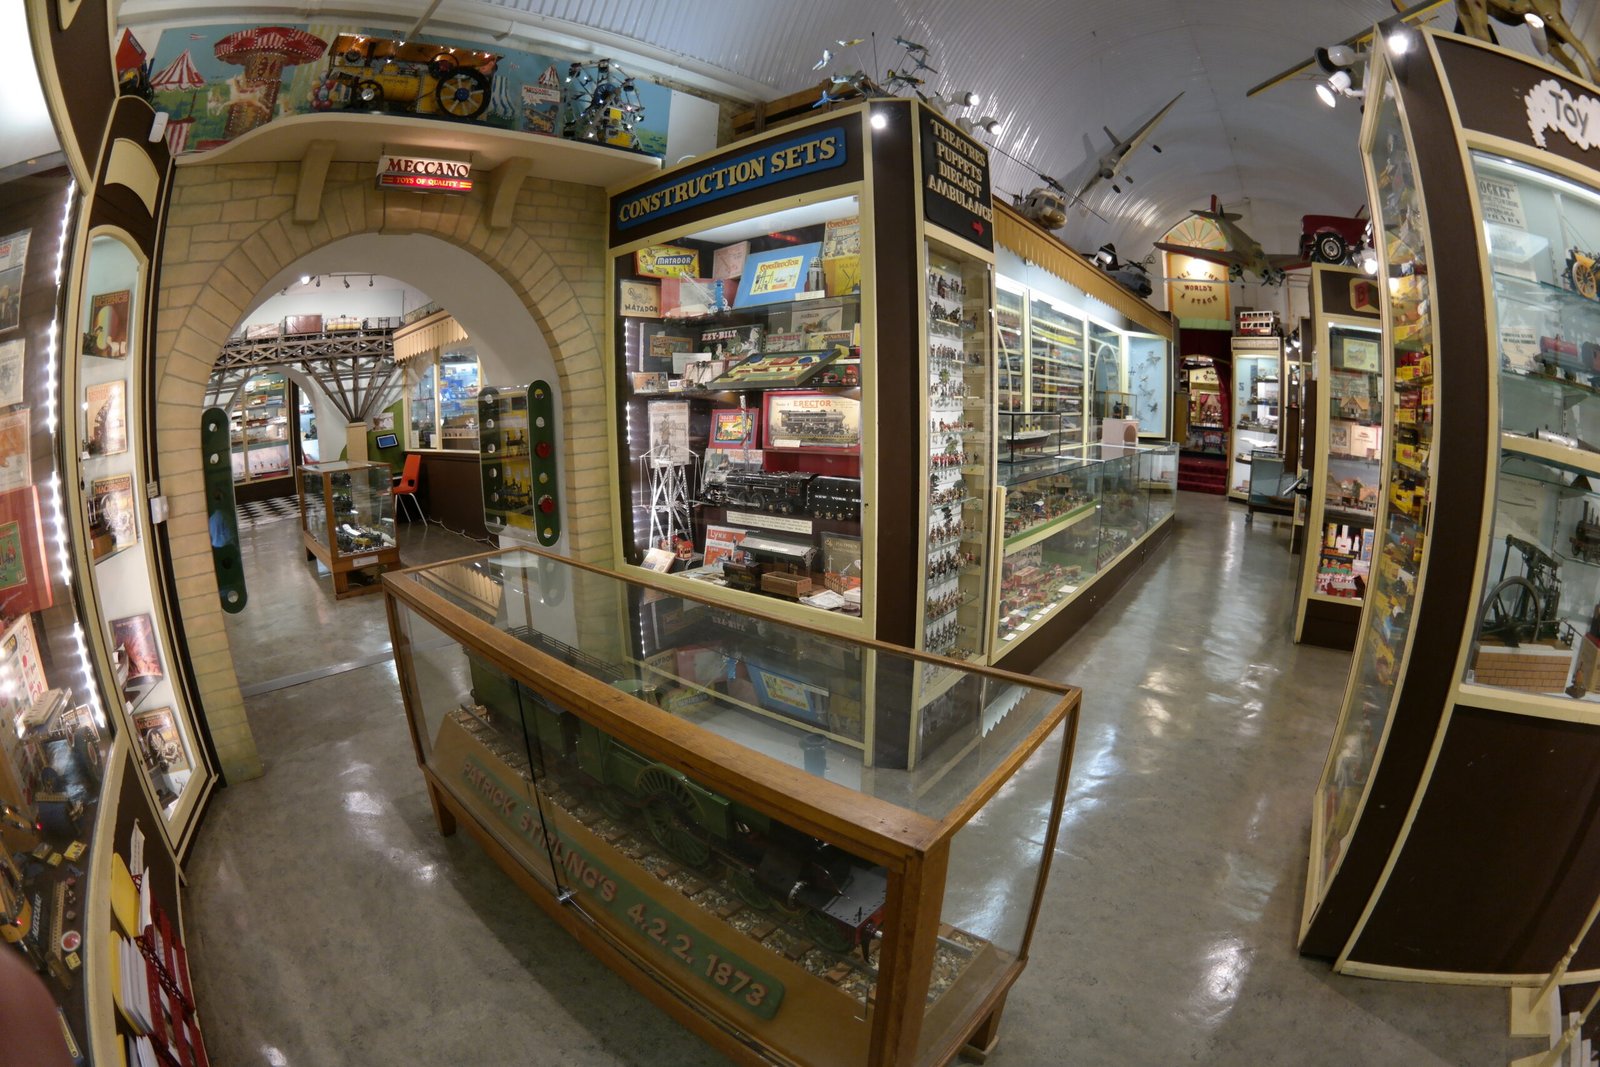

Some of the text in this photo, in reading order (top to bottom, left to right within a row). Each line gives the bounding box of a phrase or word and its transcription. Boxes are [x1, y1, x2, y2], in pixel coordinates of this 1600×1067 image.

[929, 118, 986, 168] THEATRES
[386, 158, 469, 177] MECCANO
[935, 141, 983, 183] PUPPETS
[428, 179, 458, 187] QUALITY
[618, 136, 837, 223] CONSTRUCTION SETS
[938, 160, 982, 199] DIECAST
[926, 173, 993, 222] AMBULANCE
[657, 256, 692, 265] MATADOR
[1184, 284, 1213, 292] WORLD'S
[624, 303, 658, 313] MATADOR
[1190, 294, 1218, 305] STAGE
[793, 399, 832, 408] ERECTOR
[463, 760, 517, 818] PATRICK
[519, 812, 618, 901] STIRLING'S
[704, 952, 771, 1008] 1873
